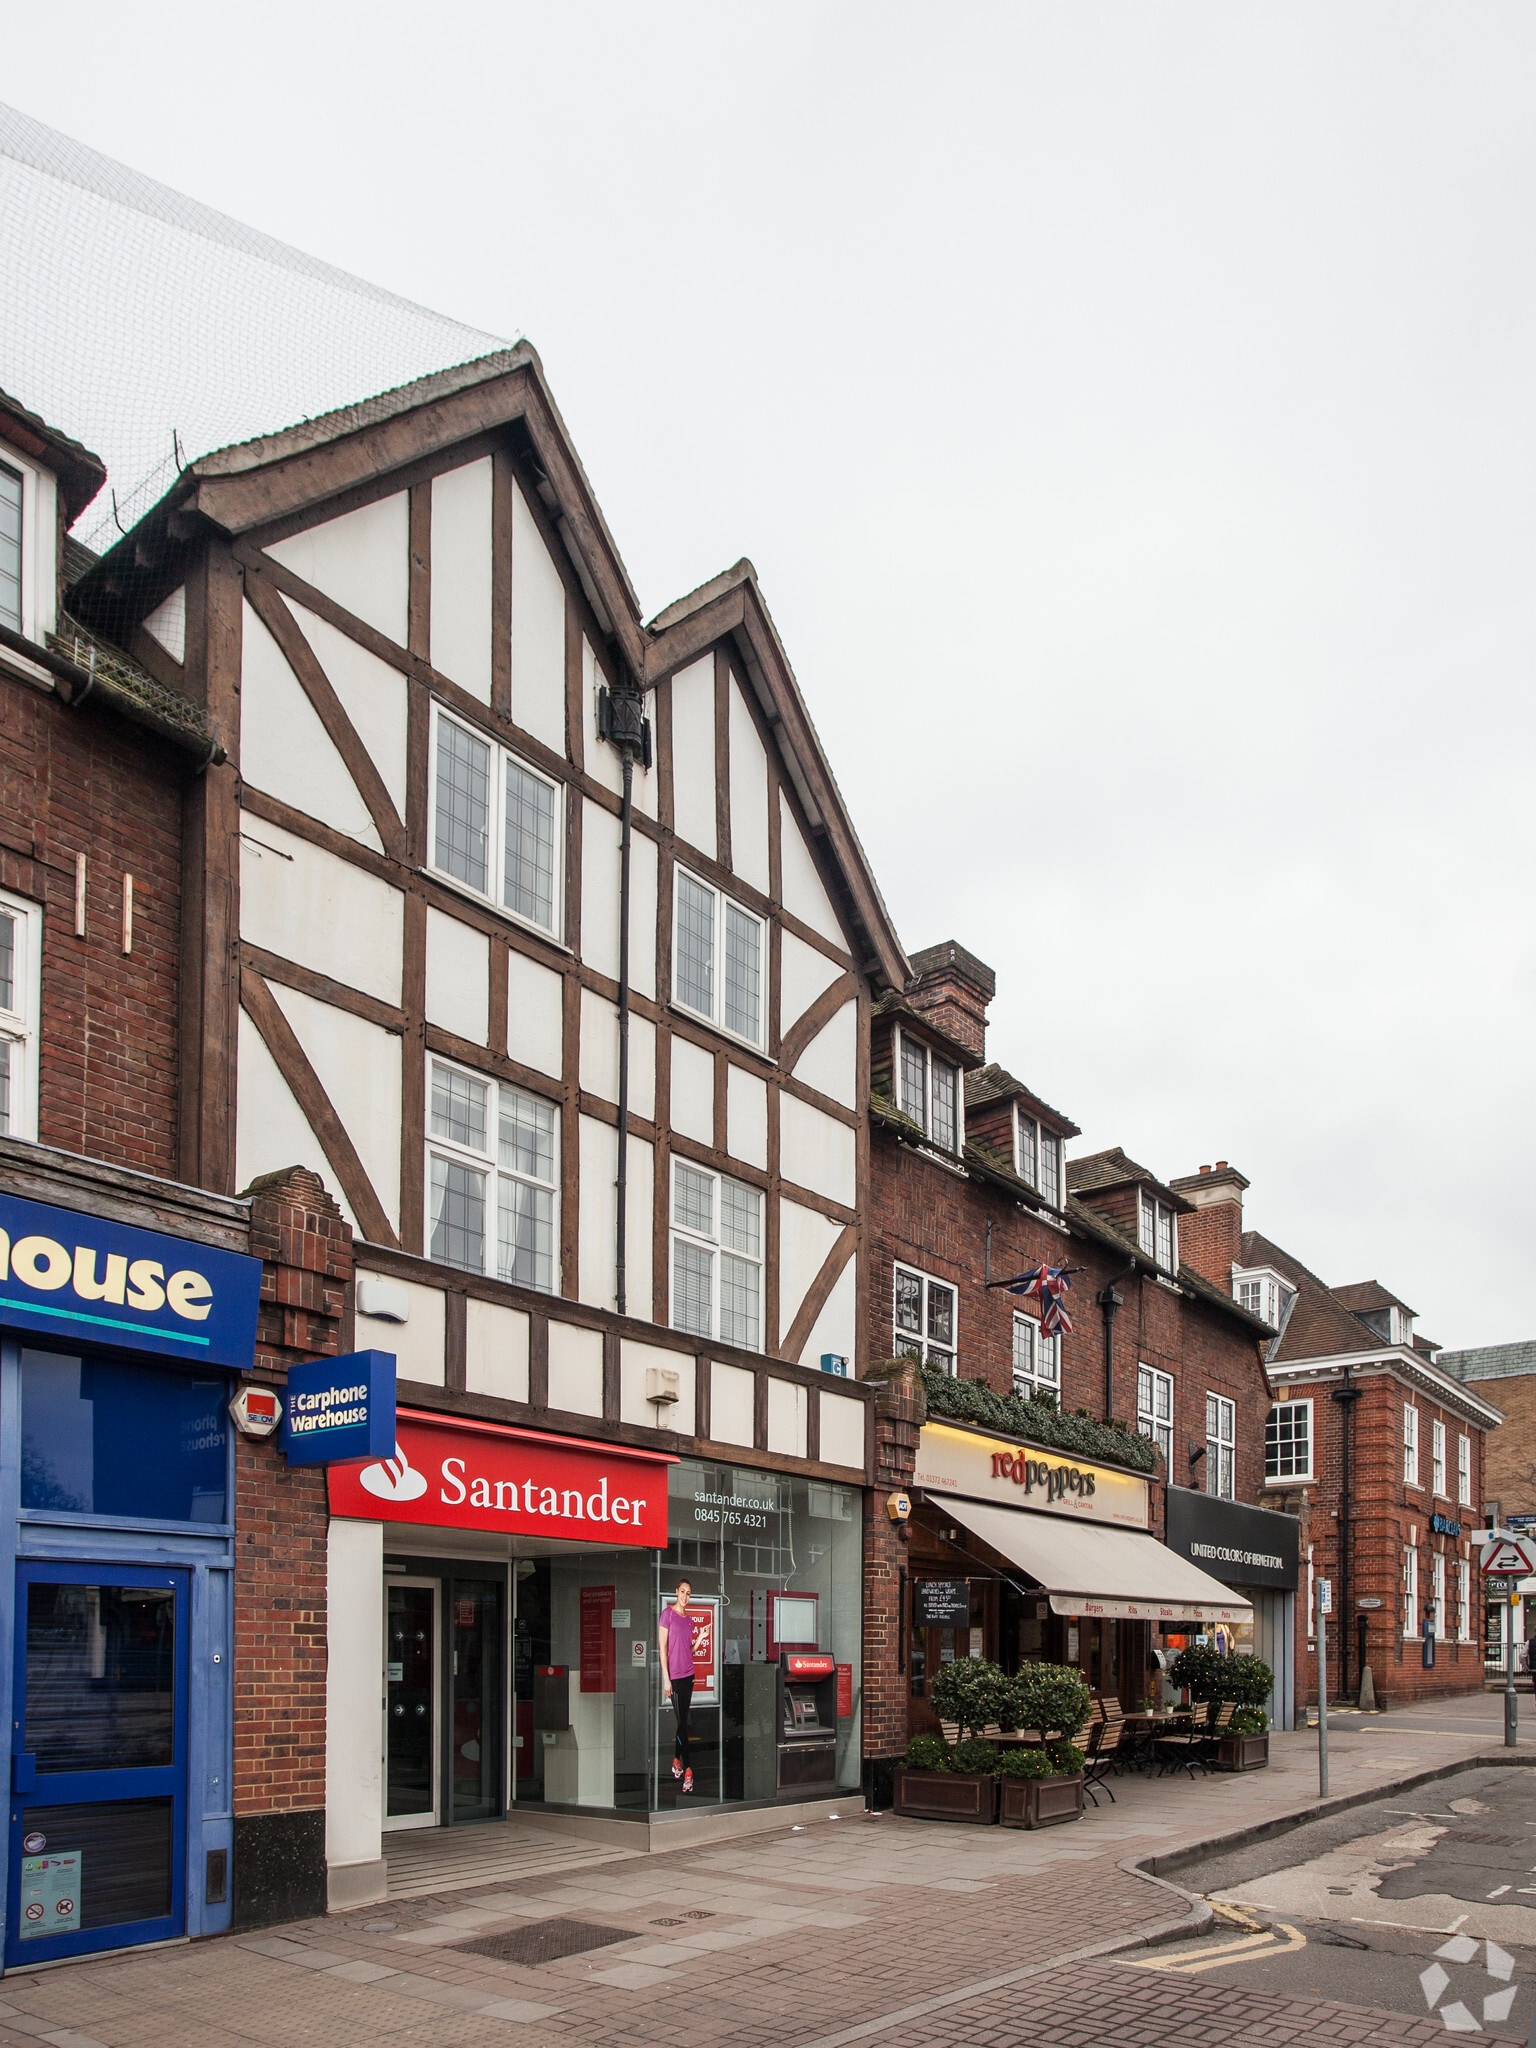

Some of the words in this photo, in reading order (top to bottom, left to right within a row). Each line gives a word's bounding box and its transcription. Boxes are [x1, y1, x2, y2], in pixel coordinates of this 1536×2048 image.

[297, 1384, 368, 1411] Carphone
[290, 1406, 368, 1432] Warehouse
[991, 1448, 1096, 1503] redpeppers
[440, 1457, 647, 1526] Santander
[694, 1491, 775, 1511] santander.co.uk
[1063, 1498, 1073, 1506] GRILL
[1078, 1501, 1093, 1510] CANTINA
[694, 1507, 720, 1523] 0845
[723, 1511, 741, 1525] 765
[743, 1513, 767, 1528] 4321
[1439, 1517, 1461, 1538] BARCLAYS
[1190, 1542, 1217, 1559] UNITED
[1216, 1546, 1243, 1563] COLORS
[1243, 1551, 1253, 1565] OF
[1085, 1602, 1104, 1614] Burgers
[1128, 1605, 1138, 1615] Ribs
[1160, 1607, 1173, 1616] Steaks
[802, 1660, 828, 1668] Santander
